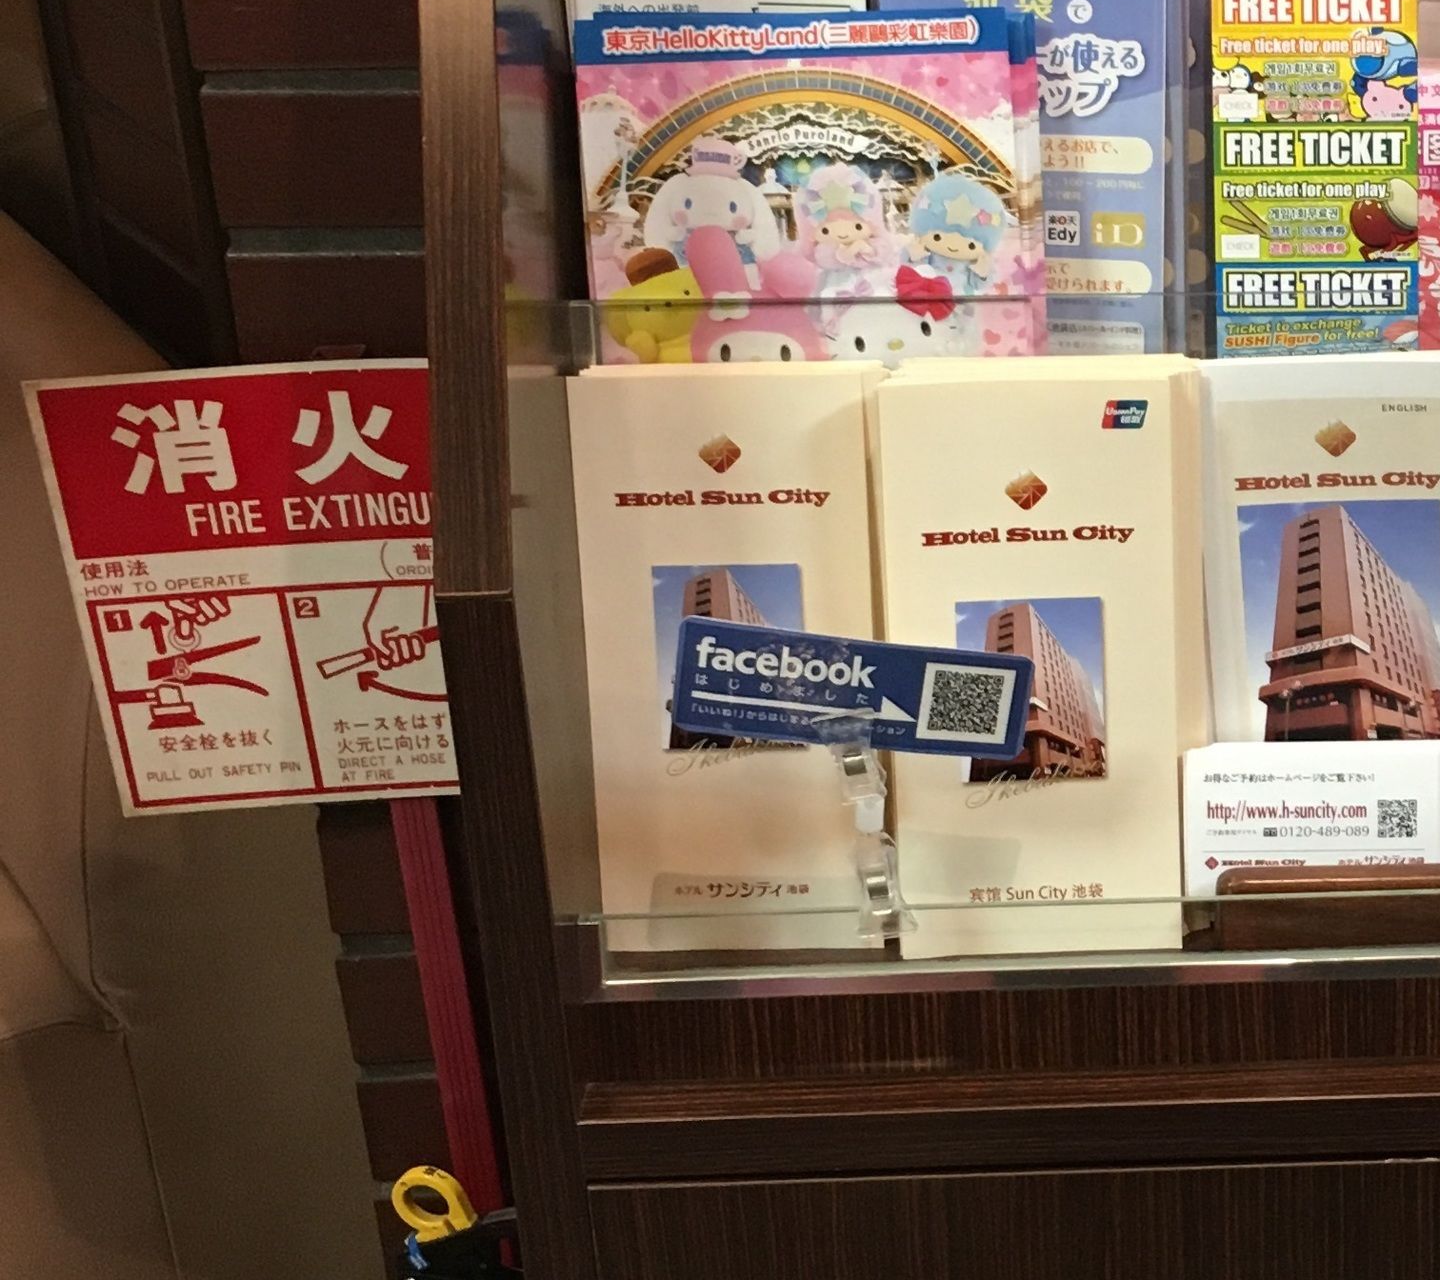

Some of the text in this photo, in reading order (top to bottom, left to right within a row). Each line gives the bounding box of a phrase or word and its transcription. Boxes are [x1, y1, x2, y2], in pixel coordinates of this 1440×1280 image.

[1221, 38, 1387, 56] Free ticket for one play.
[1224, 130, 1406, 166] FREE TICKET
[1222, 180, 1390, 201] Free ticket for one play.
[1048, 228, 1077, 243] Edy
[1226, 271, 1408, 308] FREE TICKET
[1225, 318, 1362, 336] Ticket exchange
[1224, 333, 1320, 347] SUSHI Figure
[1234, 473, 1312, 491] Hotel
[1317, 473, 1377, 488] Sun
[614, 488, 831, 508] Hotel Sun City
[185, 501, 267, 537] FIRE
[921, 524, 1135, 548] Hotel Sun City
[80, 560, 150, 582] 使用法
[84, 573, 251, 597] HOW TO OPERATE
[695, 636, 878, 689] facebook
[333, 713, 447, 733] ホースをはず
[159, 731, 274, 754] 安全栓を抜く
[337, 735, 450, 754] 火元に向ける
[338, 753, 447, 769] DIRECT HOSE
[146, 763, 273, 783] PULL OUT SAFETY
[340, 770, 361, 782] AT
[1207, 800, 1367, 824] http://www.h-suncity.com
[1280, 826, 1370, 837] 0120-489-089
[707, 881, 783, 900] サンシティ
[970, 883, 1104, 903] 宾馆 Sun City 池袋
